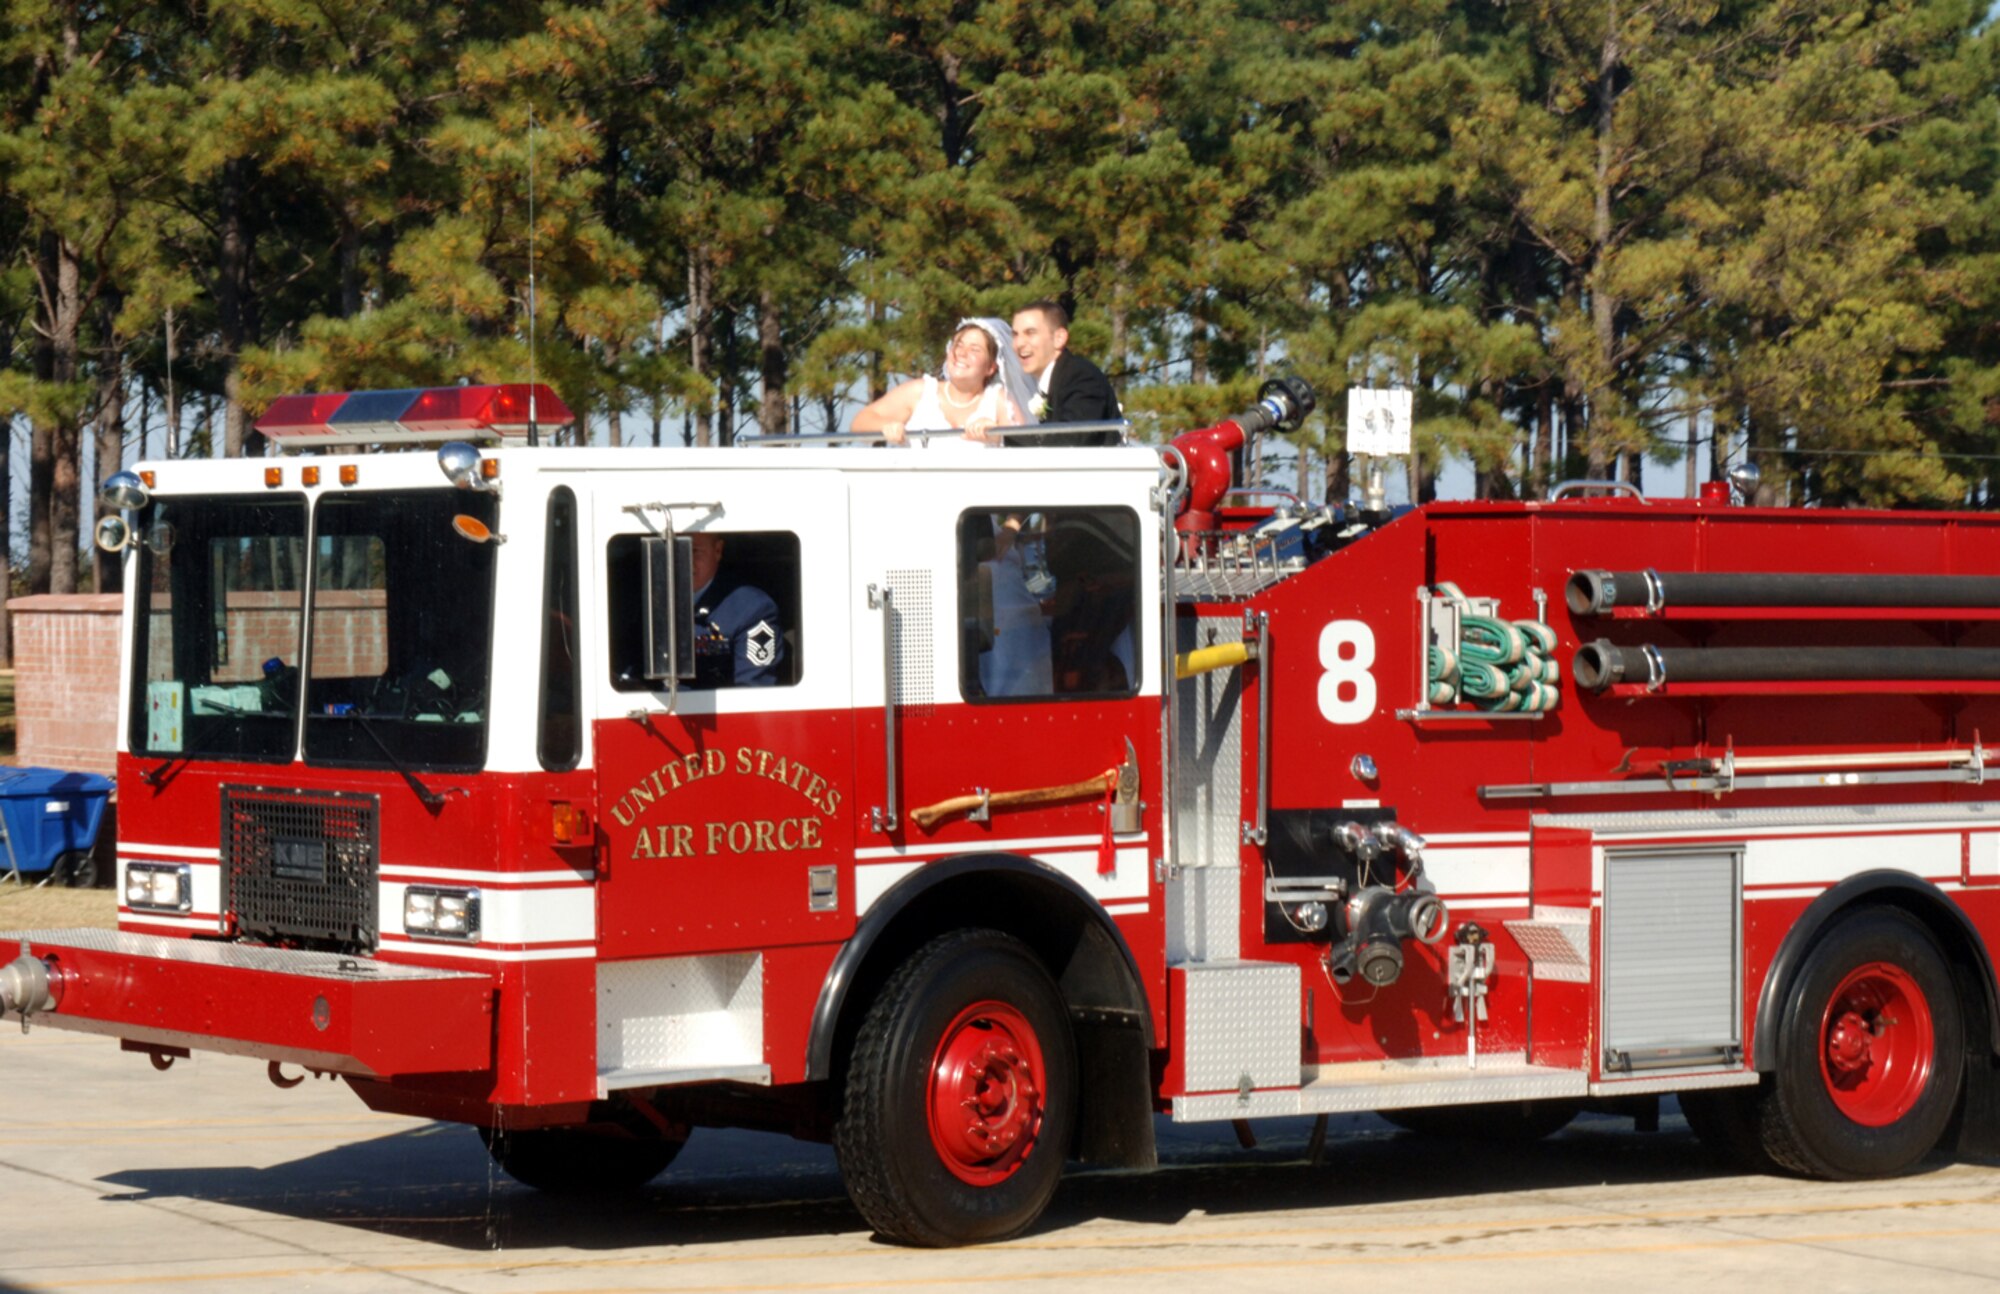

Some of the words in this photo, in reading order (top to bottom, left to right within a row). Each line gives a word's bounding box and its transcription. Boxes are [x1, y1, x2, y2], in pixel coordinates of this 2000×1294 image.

[1317, 619, 1377, 724] 8
[610, 748, 727, 827] UNITED
[735, 746, 842, 816] STATES
[631, 824, 696, 859] AIR
[705, 817, 822, 855] FORCE
